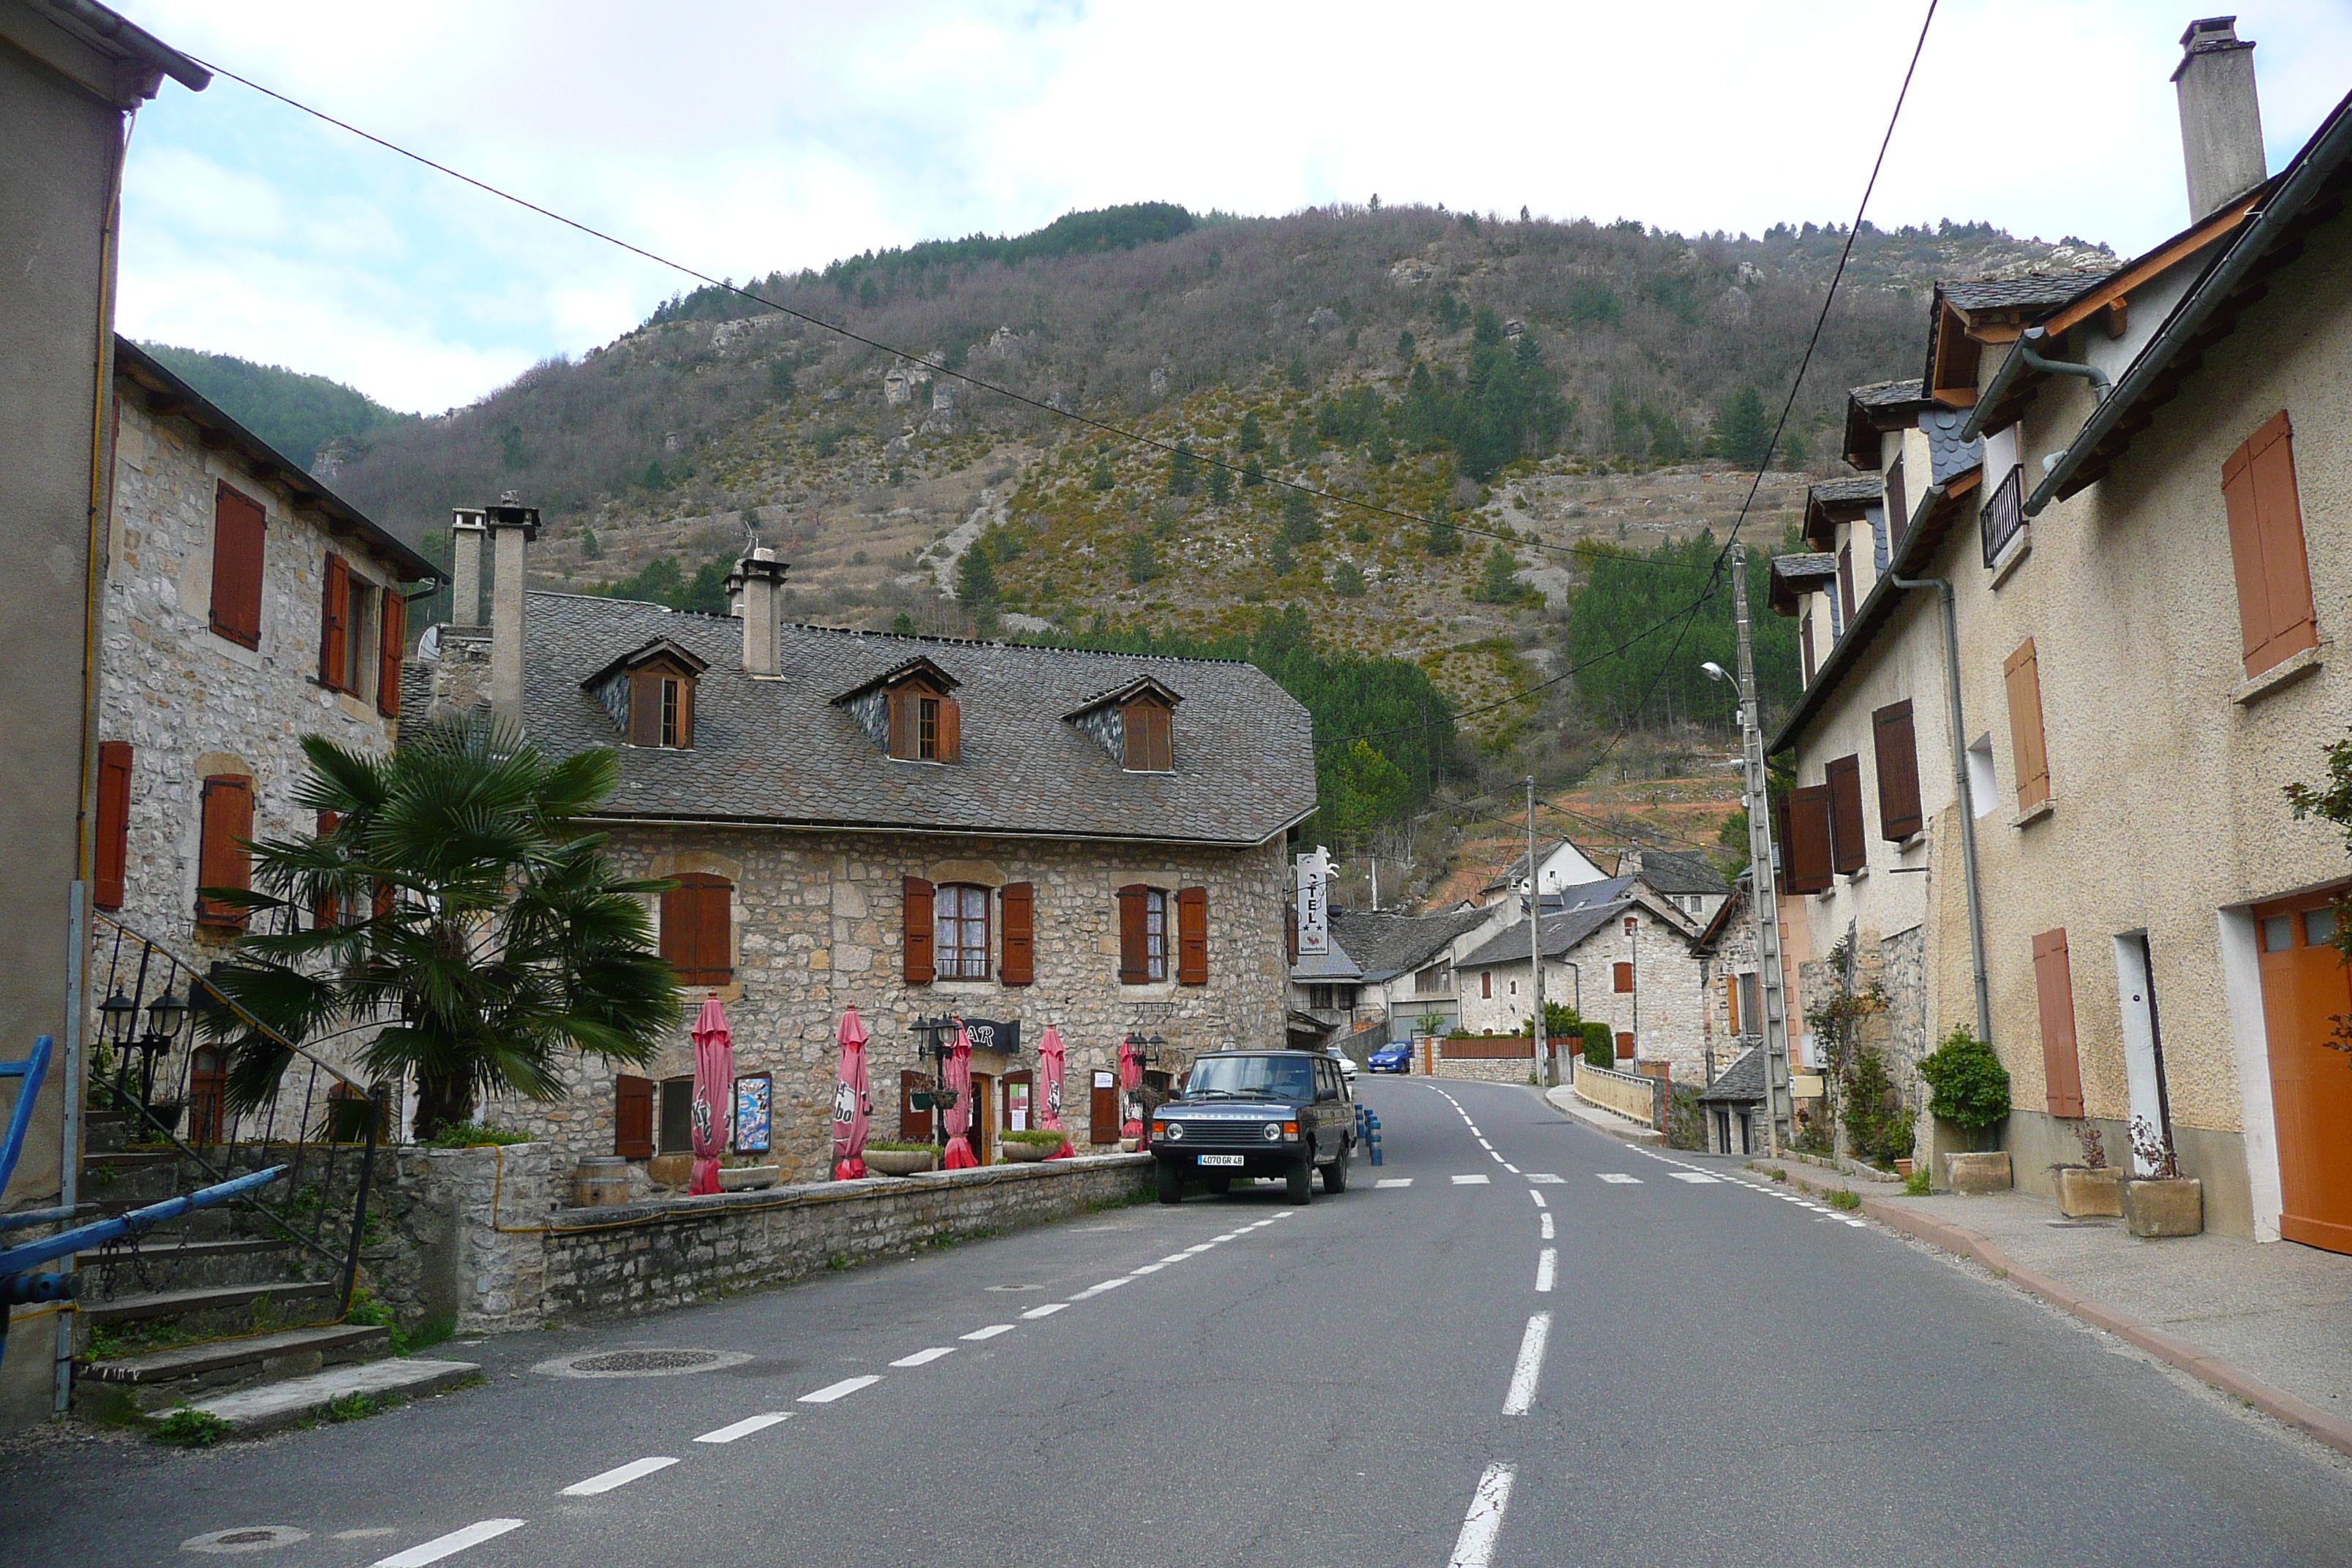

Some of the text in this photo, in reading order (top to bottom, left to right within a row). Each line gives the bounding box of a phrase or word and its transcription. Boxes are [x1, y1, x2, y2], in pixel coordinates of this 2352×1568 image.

[966, 1025, 994, 1047] AR
[1203, 1156, 1243, 1165] 4070 GR 48
